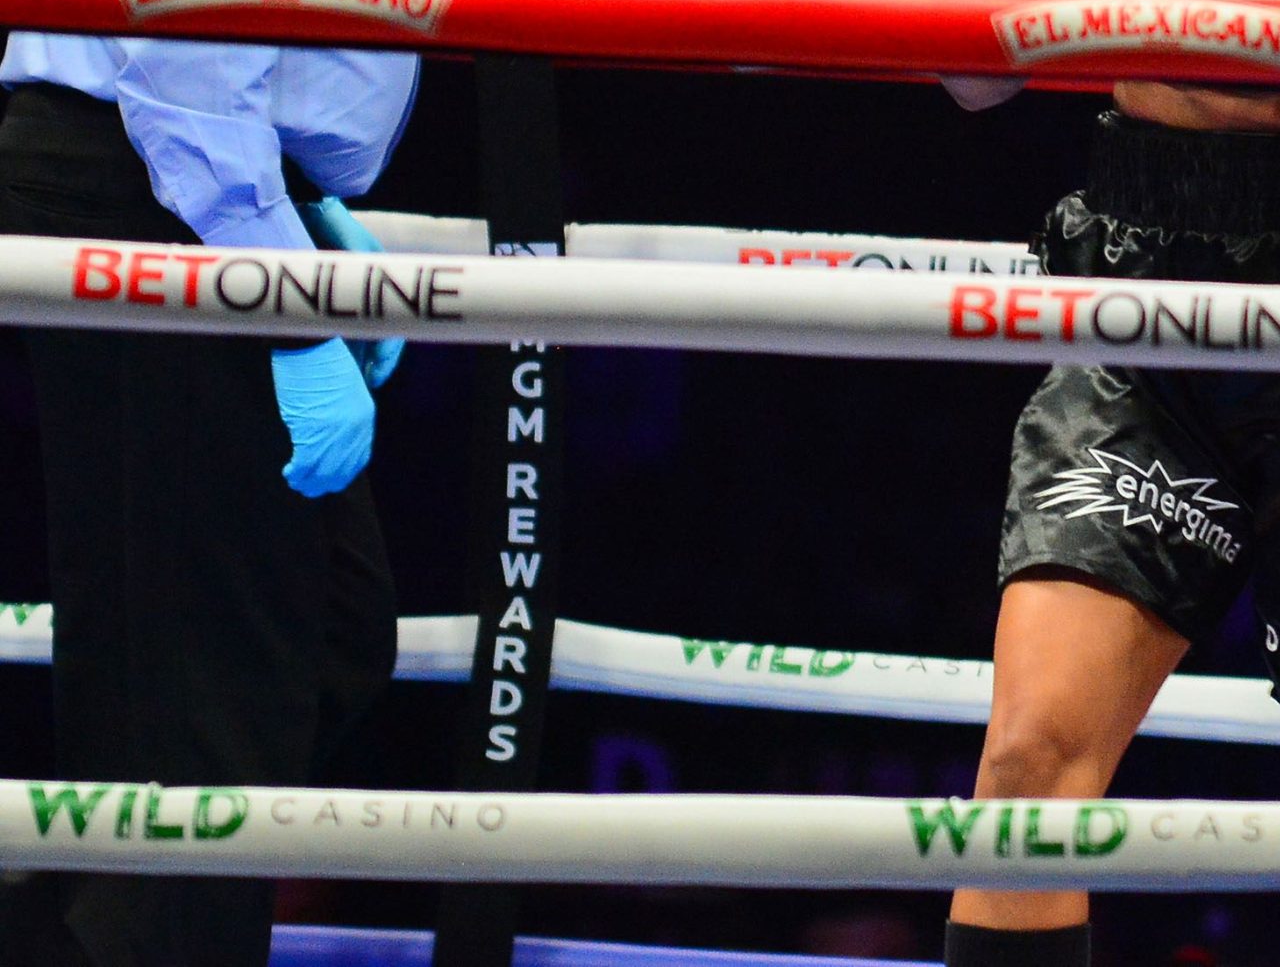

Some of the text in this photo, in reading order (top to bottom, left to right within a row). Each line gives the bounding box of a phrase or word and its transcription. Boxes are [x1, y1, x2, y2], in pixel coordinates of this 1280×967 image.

[1013, 11, 1069, 50] EL
[71, 246, 465, 321] BETONLINE
[485, 462, 542, 762] REWARDS
[680, 638, 855, 678] WILD
[27, 781, 508, 840] WILD CASINO
[907, 799, 1130, 859] WILD
